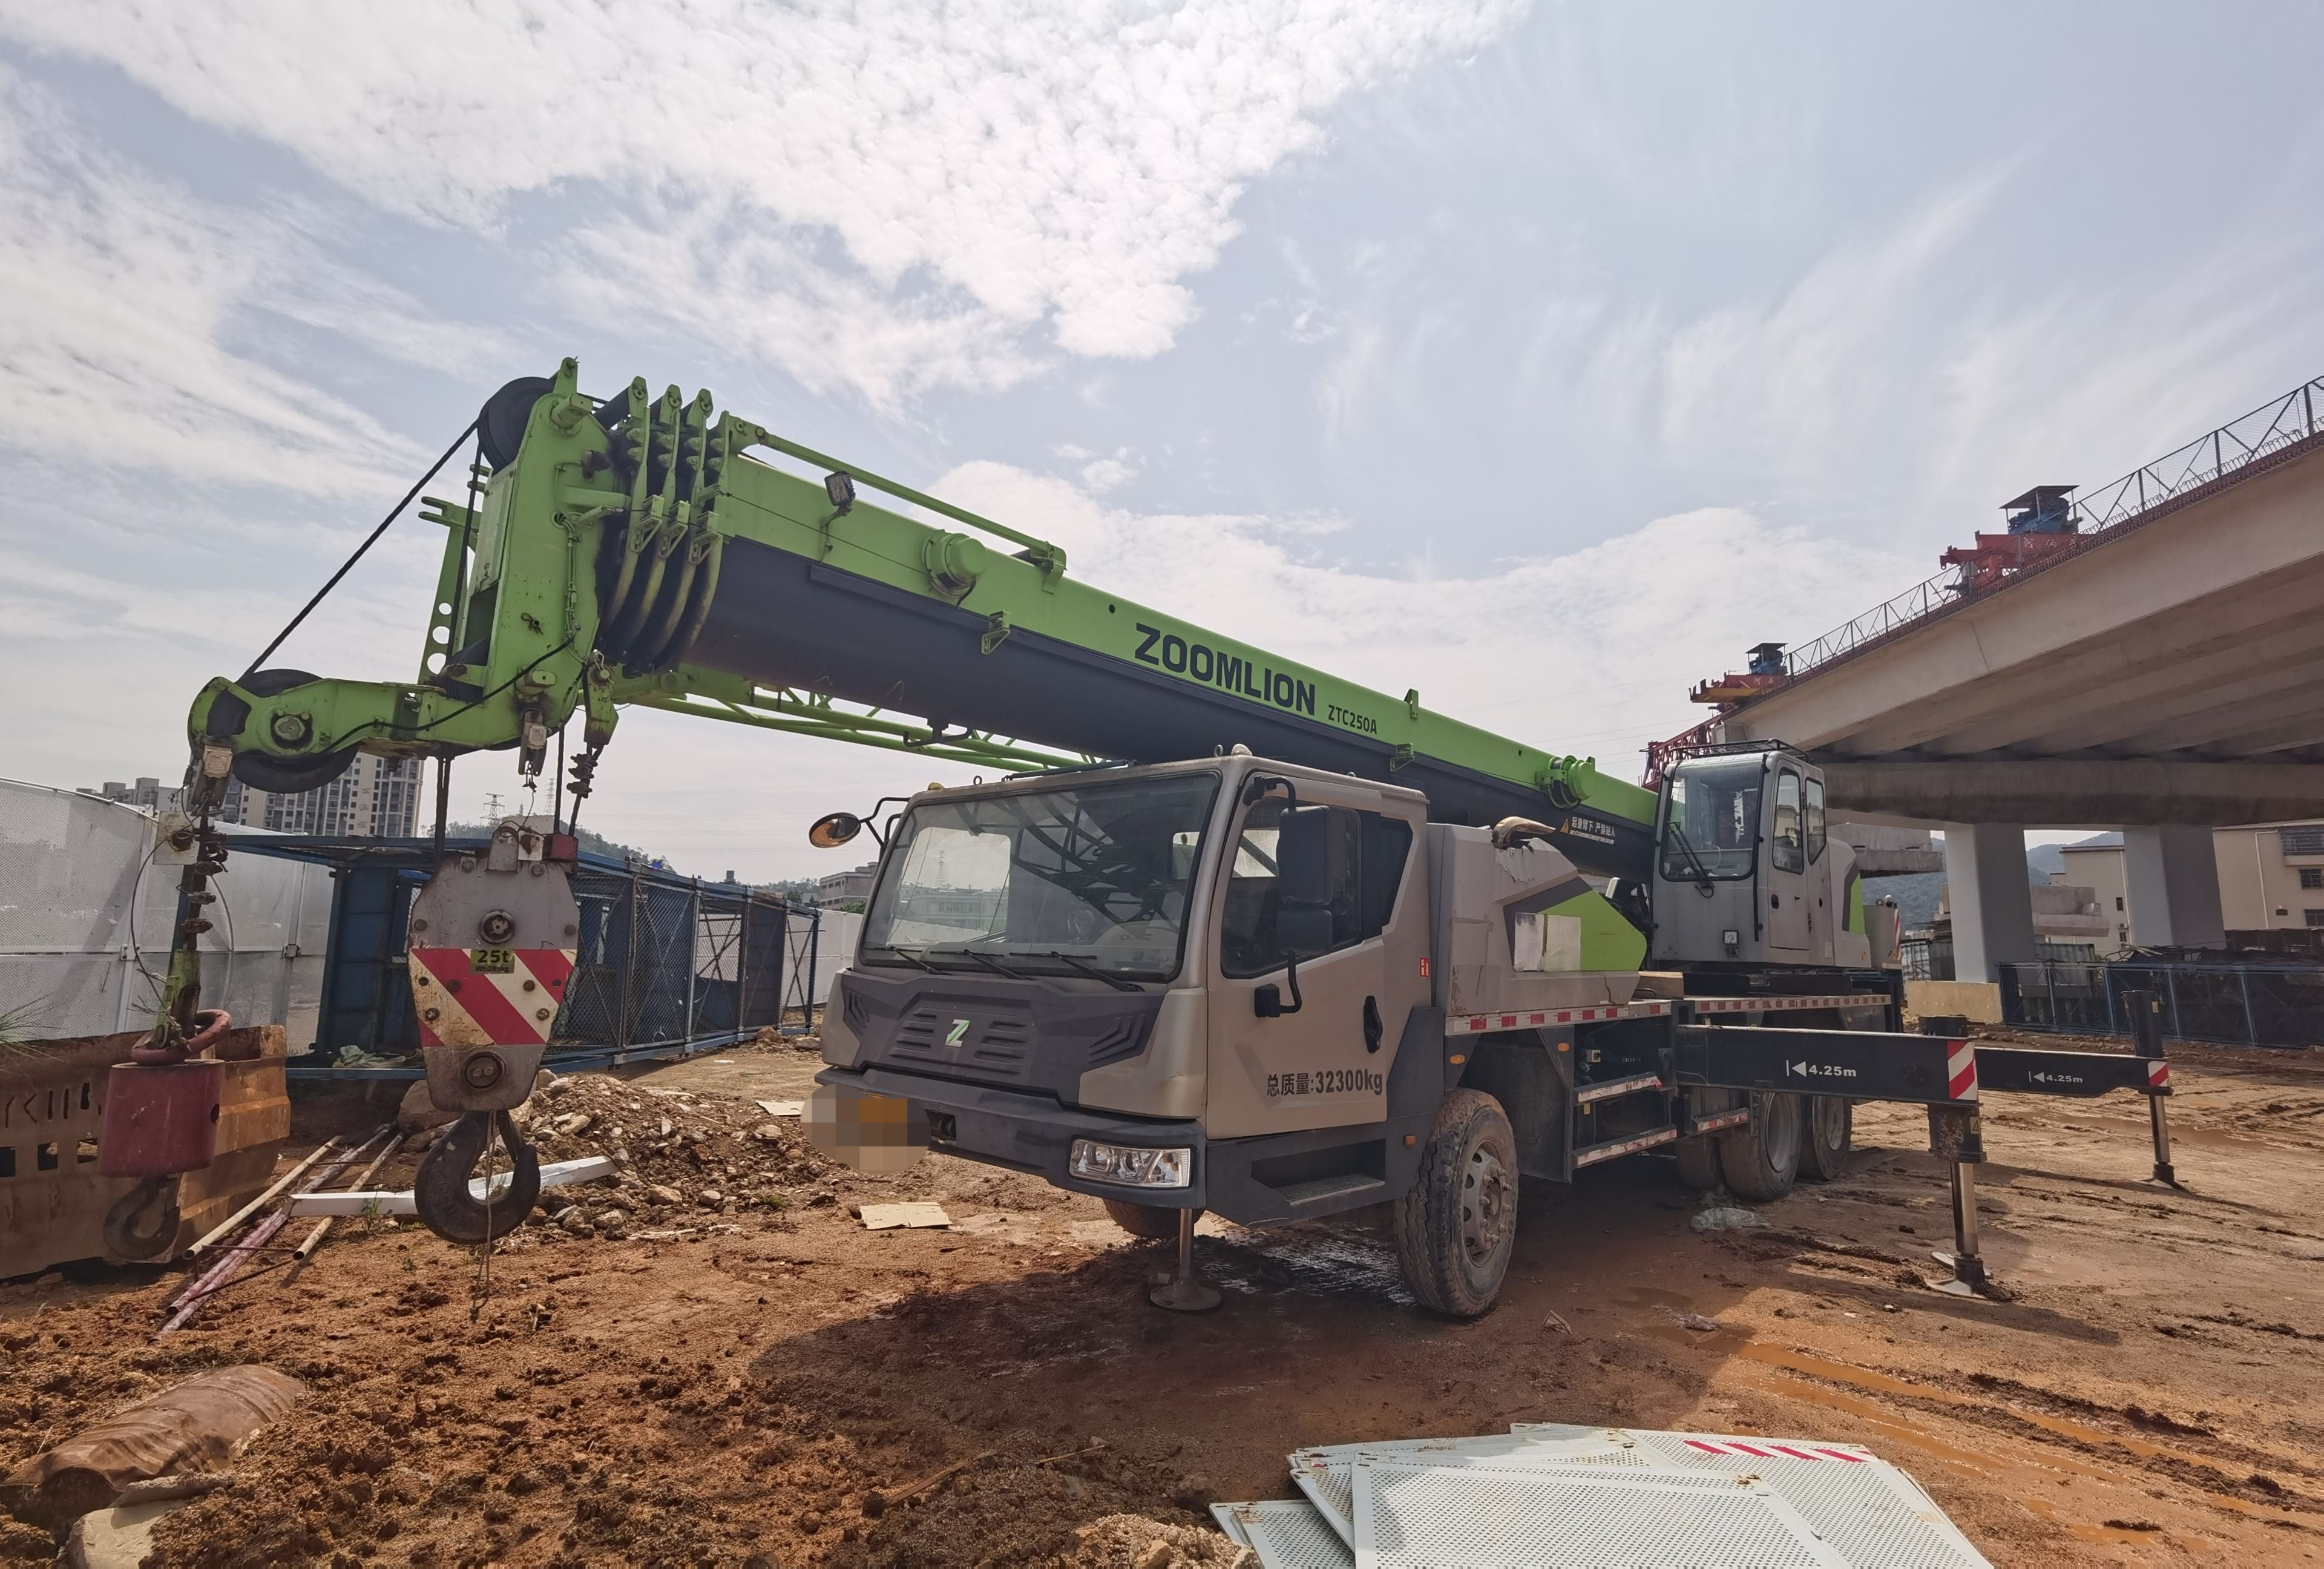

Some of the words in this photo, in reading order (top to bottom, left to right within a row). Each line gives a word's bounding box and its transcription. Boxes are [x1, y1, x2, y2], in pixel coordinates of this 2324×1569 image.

[1135, 622, 1315, 715] ZOOMLION
[1328, 705, 1377, 735] ZTC250A
[478, 950, 509, 962] 25t
[1808, 1065, 1856, 1077] 4.25m
[2046, 1074, 2083, 1084] 4.25m
[1267, 1069, 1383, 1097] 总质量:32300kg
